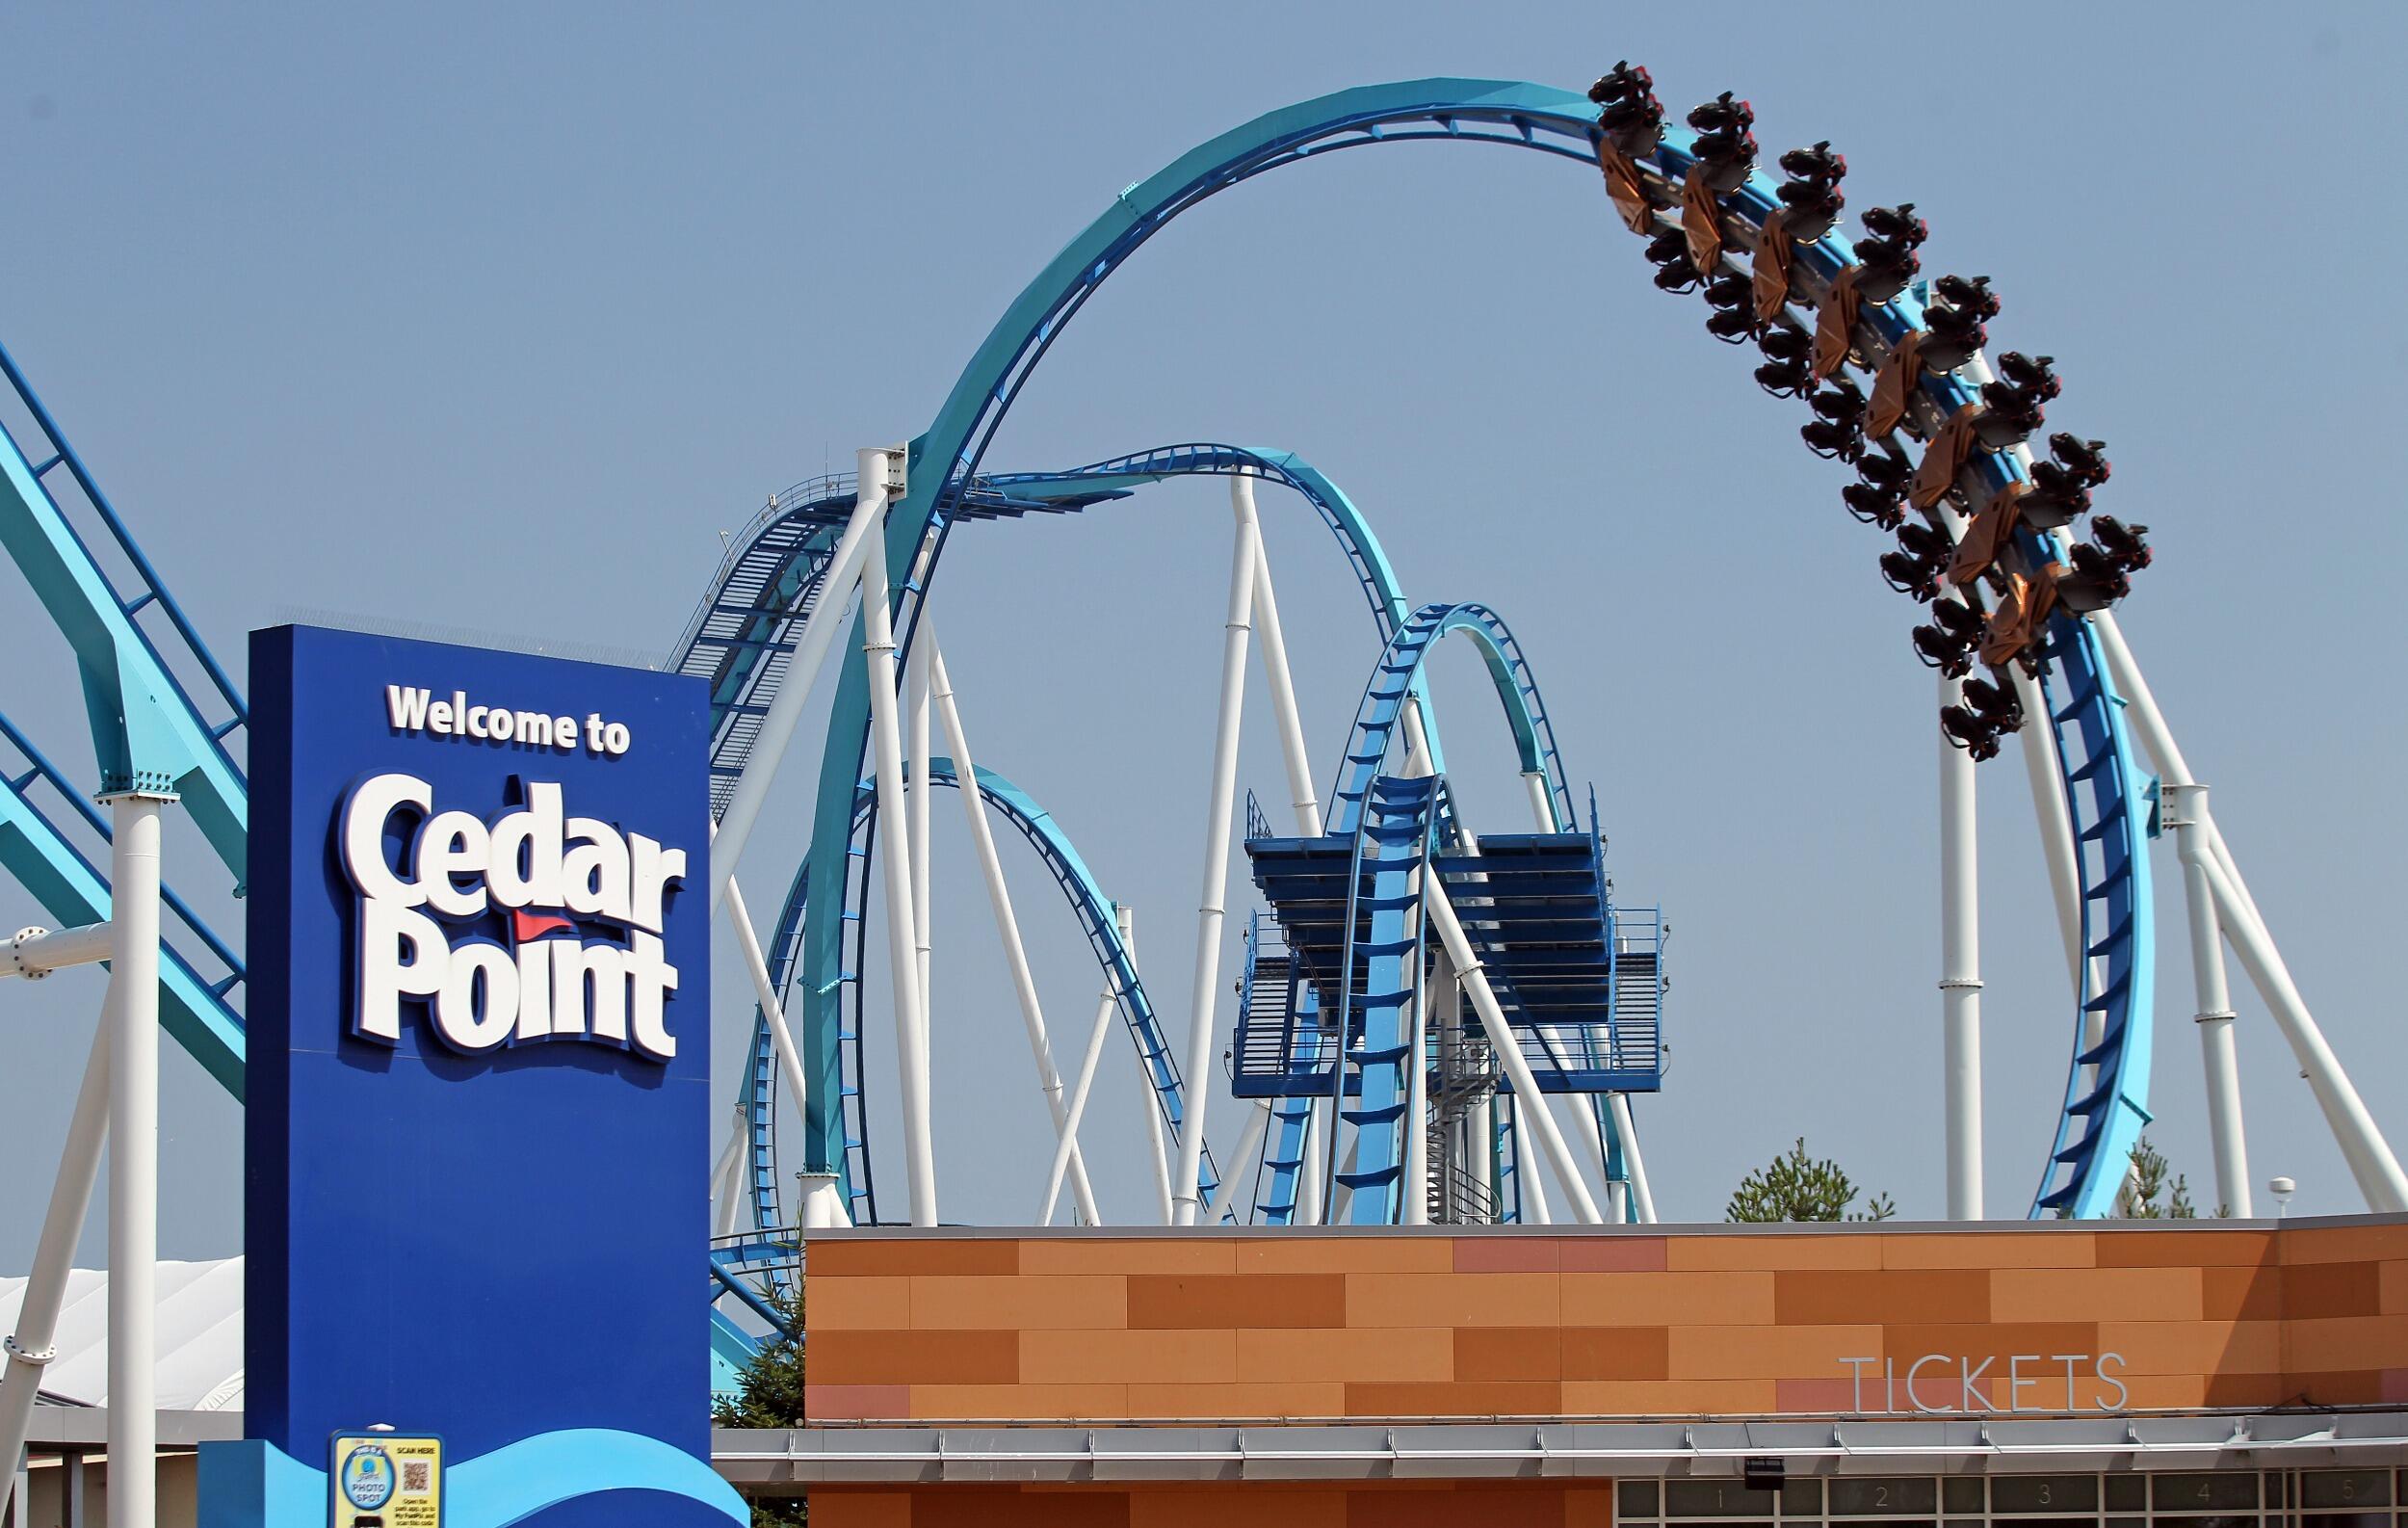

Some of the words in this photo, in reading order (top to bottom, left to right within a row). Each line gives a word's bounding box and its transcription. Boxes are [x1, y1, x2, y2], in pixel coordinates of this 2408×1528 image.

[386, 684, 578, 750] Welcome
[586, 713, 631, 755] to
[344, 773, 687, 935] Cedar
[359, 897, 679, 1058] Point
[1837, 1352, 2128, 1414] TICKETS
[353, 1484, 385, 1492] PHOTO
[1875, 1487, 1888, 1507] 2
[2038, 1484, 2052, 1505] 3
[2197, 1483, 2211, 1502] 4
[2343, 1479, 2354, 1499] 5
